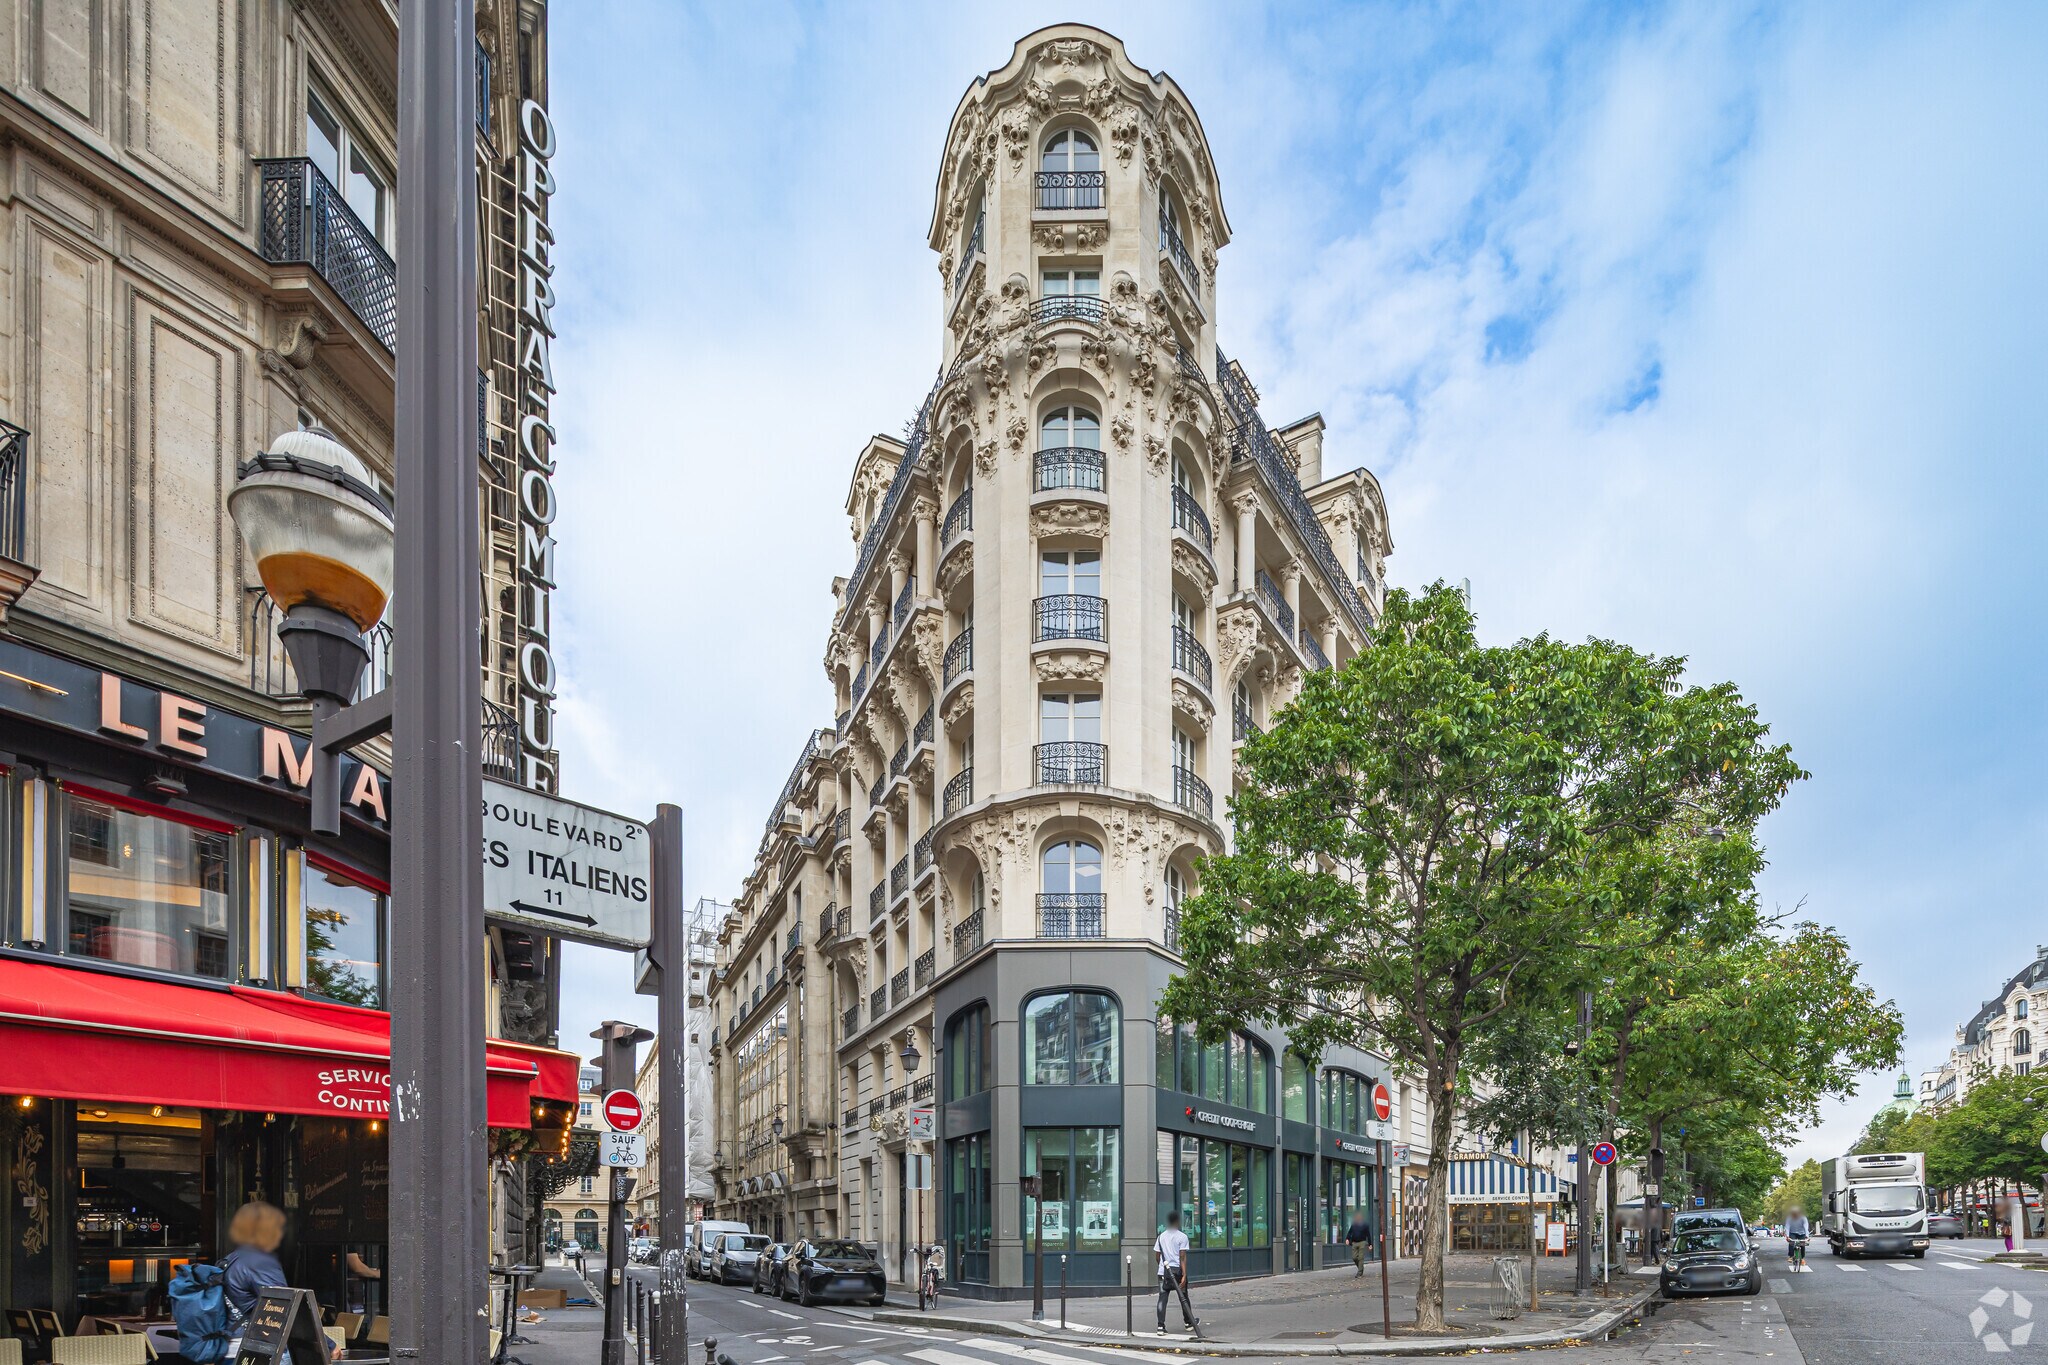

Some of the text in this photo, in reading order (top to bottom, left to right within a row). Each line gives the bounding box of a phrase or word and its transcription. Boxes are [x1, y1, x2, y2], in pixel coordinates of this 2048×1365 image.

[98, 671, 208, 759] LE
[482, 836, 648, 903] S ITALIENS
[543, 888, 563, 906] 11
[611, 1134, 636, 1145] SAUF
[1453, 1152, 1491, 1161] GRAMONT
